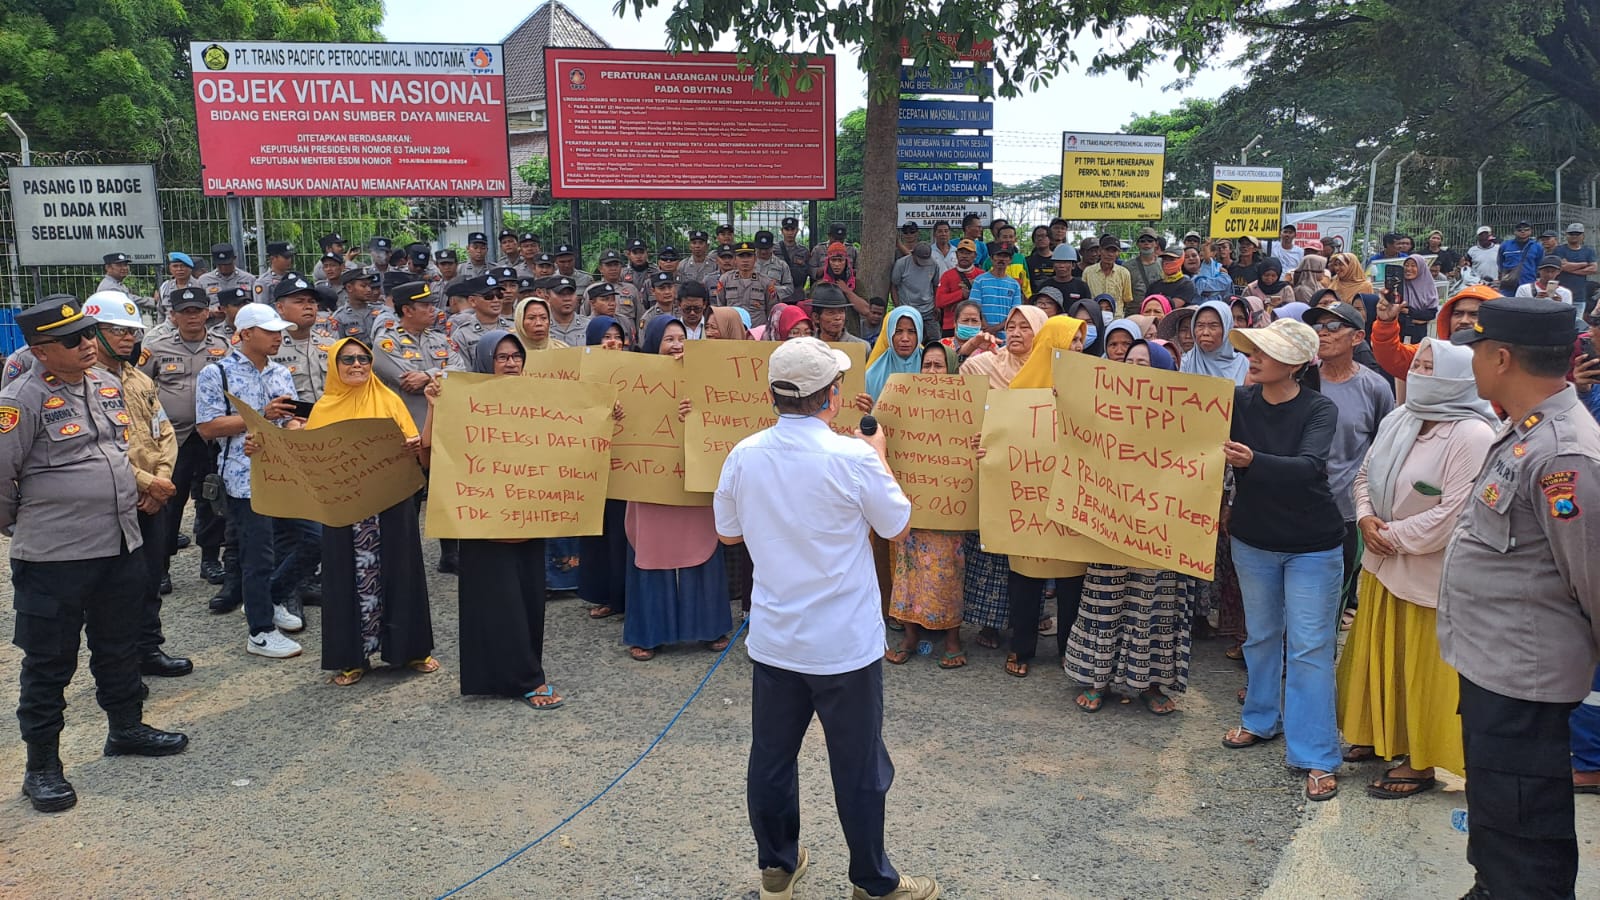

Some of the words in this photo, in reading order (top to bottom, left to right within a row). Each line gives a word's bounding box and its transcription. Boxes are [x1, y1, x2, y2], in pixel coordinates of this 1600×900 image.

[235, 48, 250, 65] PT.
[252, 48, 285, 66] TRANS
[288, 49, 326, 66] PACIFIC
[328, 50, 412, 67] PETROCHEMICAL
[415, 50, 466, 68] INDOTAMA
[600, 72, 661, 80] PERATURAN
[664, 73, 718, 82] LARANGAN
[722, 74, 754, 82] UNJUK
[198, 79, 287, 104] OBJEK
[292, 79, 364, 104] VITAL
[370, 80, 501, 105] NASIONAL
[655, 85, 680, 93] PADA
[682, 86, 733, 94] OBVITNAS
[210, 110, 259, 121] BIDANG
[263, 110, 310, 122] ENERGI
[314, 110, 339, 122] DAN
[342, 110, 396, 122] SUMBER
[400, 112, 434, 122] DAYA
[436, 112, 490, 122] MINERAL
[898, 108, 928, 120] ECEPATAN
[298, 134, 347, 142] DITETAPKAN
[349, 135, 412, 143] BERDASARKAN:
[261, 145, 308, 154] KEPUTUSAN
[311, 146, 350, 154] PRESIDEN
[352, 146, 360, 154] RI
[362, 146, 392, 154] NOMOR
[394, 146, 402, 154] 63
[405, 146, 430, 154] TAHUN
[433, 146, 450, 154] 2004
[936, 150, 952, 158] YANG
[250, 156, 299, 164] KEPUTUSAN
[1098, 158, 1114, 166] TELAH
[1116, 158, 1154, 166] MENERAPKAN
[904, 172, 942, 181] BERJALAN
[954, 173, 981, 181] TEMPAT
[1079, 168, 1100, 176] PERPOL
[23, 179, 76, 194] PASANG
[80, 179, 92, 194] ID
[97, 178, 142, 194] BADGE
[208, 178, 263, 190] DILARANG
[266, 178, 304, 190] MASUK
[306, 178, 358, 190] DAN/ATAU
[362, 178, 448, 190] MEMANFAATKAN
[450, 179, 484, 190] TANPA
[486, 180, 506, 191] IZIN
[900, 184, 916, 192] ANG
[919, 184, 942, 192] TELAH
[944, 184, 988, 192] DISEDIAKAN
[1100, 180, 1126, 188] TENTANG
[1064, 190, 1084, 198] SISTEM
[44, 202, 56, 218] DI
[61, 202, 96, 217] DADA
[100, 202, 126, 216] KIRI
[32, 225, 93, 240] SEBELUM
[97, 224, 144, 240] MASUK
[1225, 219, 1246, 232] CCTV
[1249, 219, 1258, 232] 24
[1261, 219, 1278, 232] JAM
[1094, 367, 1231, 422] TUNTUTAN
[468, 396, 584, 425] KELUARKAN
[466, 425, 538, 446] DIREKSI
[548, 433, 586, 447] DARI
[1070, 416, 1206, 481] KOMPENSASI
[492, 461, 550, 478] RUWET
[1062, 456, 1072, 477] 2
[1078, 458, 1159, 511] PRIORITAS
[456, 481, 495, 499] DESA
[504, 484, 585, 504] BERDAMPAK
[1056, 498, 1064, 512] 3
[456, 506, 492, 520] TDK
[500, 508, 580, 529] SEJAHTERA
[1078, 484, 1168, 542] PERMANEN
